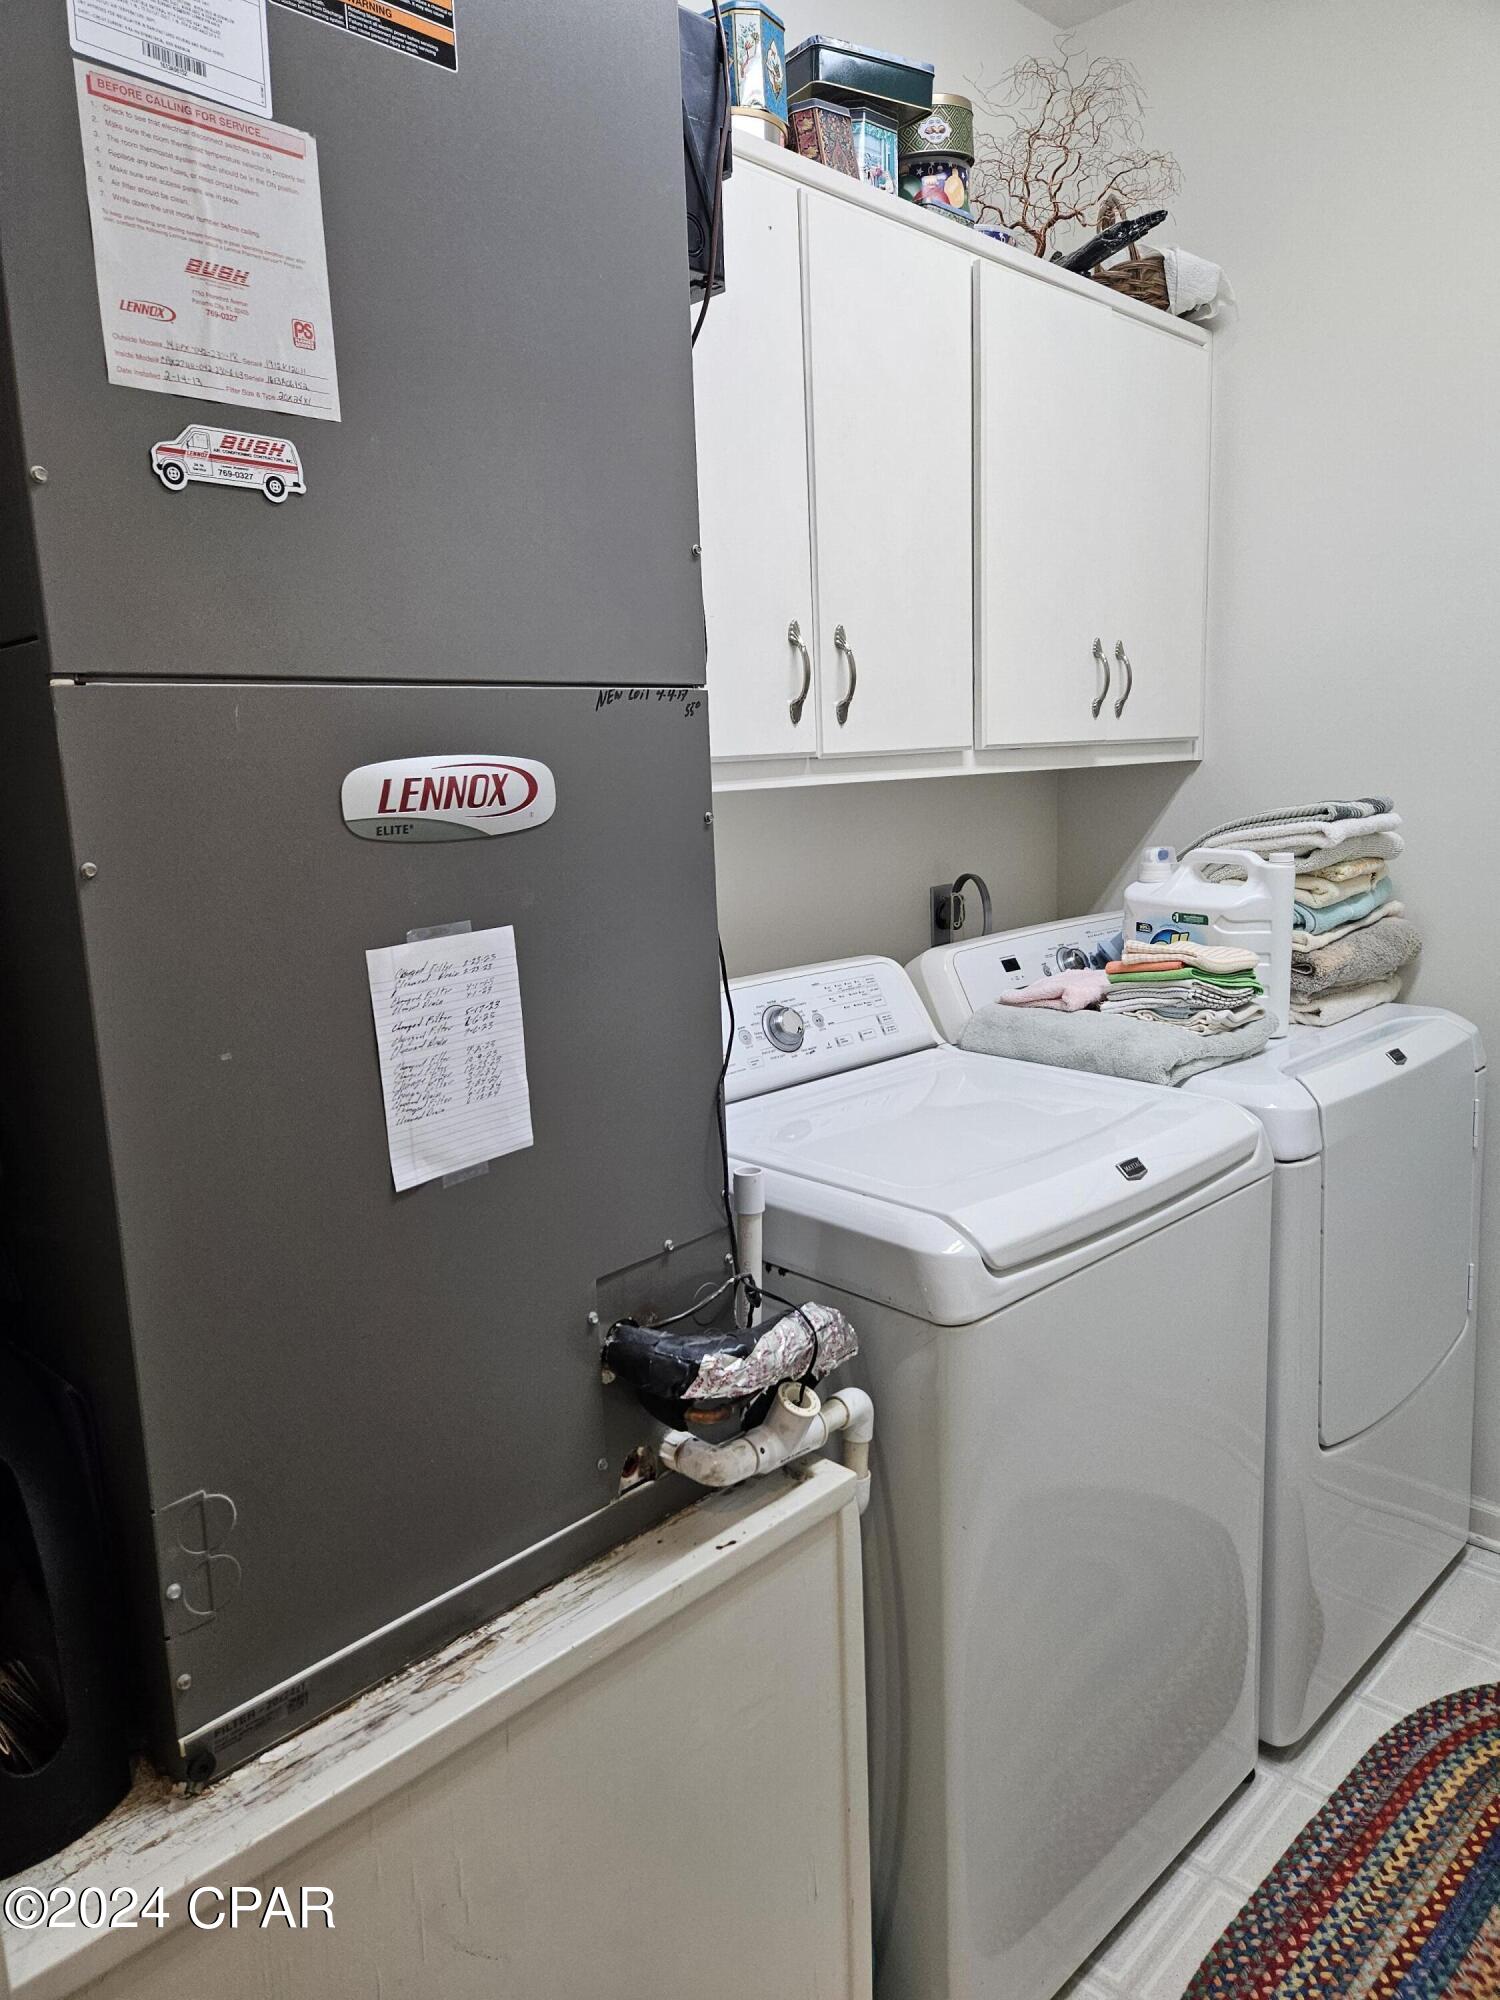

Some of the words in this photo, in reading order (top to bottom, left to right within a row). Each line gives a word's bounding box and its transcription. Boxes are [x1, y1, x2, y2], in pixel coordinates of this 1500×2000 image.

[97, 78, 142, 100] BEFORE
[145, 94, 192, 115] CALLING
[196, 110, 217, 124] FOR
[185, 257, 250, 284] BUSH
[119, 299, 165, 319] LENNOX
[294, 320, 314, 340] PS
[186, 449, 209, 459] LENNOX
[220, 434, 287, 458] BUSH
[217, 468, 254, 480] 769-0327
[378, 772, 509, 815] LENNOX
